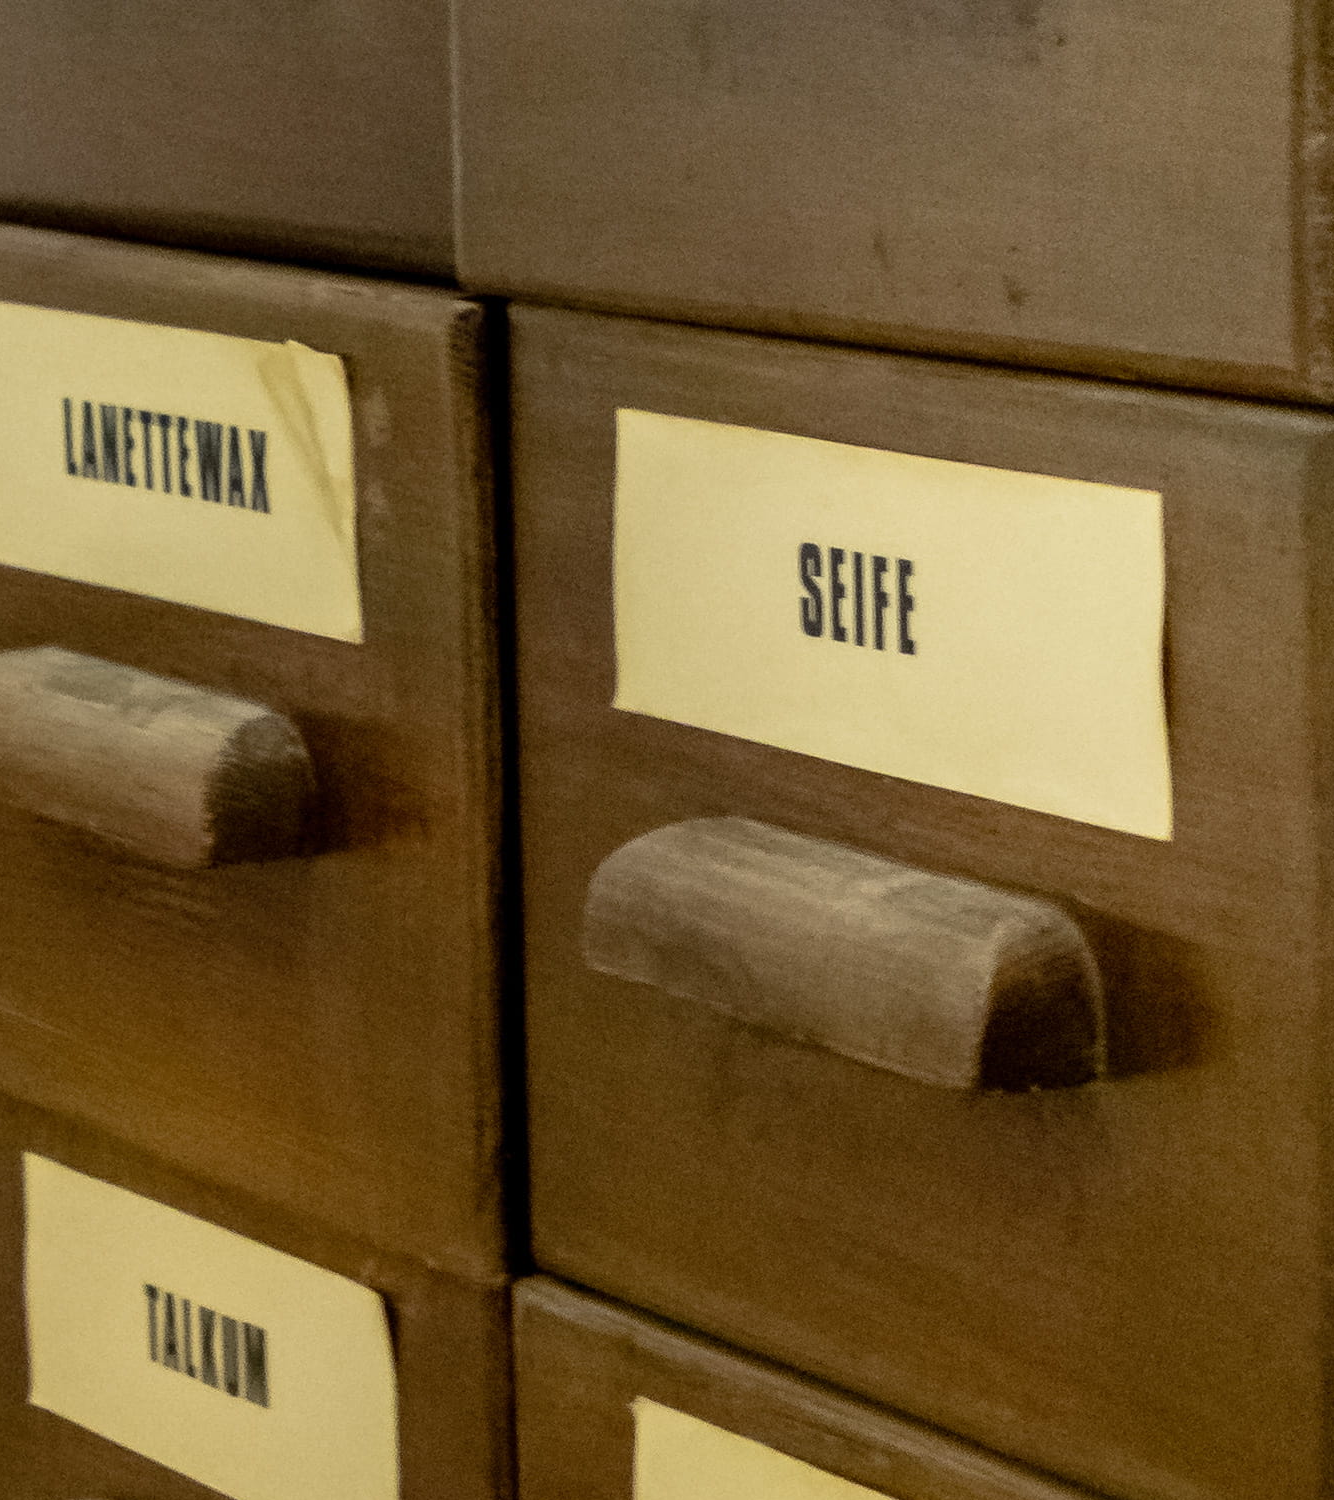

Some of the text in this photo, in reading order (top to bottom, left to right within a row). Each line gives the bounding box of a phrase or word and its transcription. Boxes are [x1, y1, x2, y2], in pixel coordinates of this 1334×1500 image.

[62, 397, 272, 515] LANETTEWAX
[797, 541, 917, 657] SEIFE
[143, 1283, 271, 1409] TALKUM
